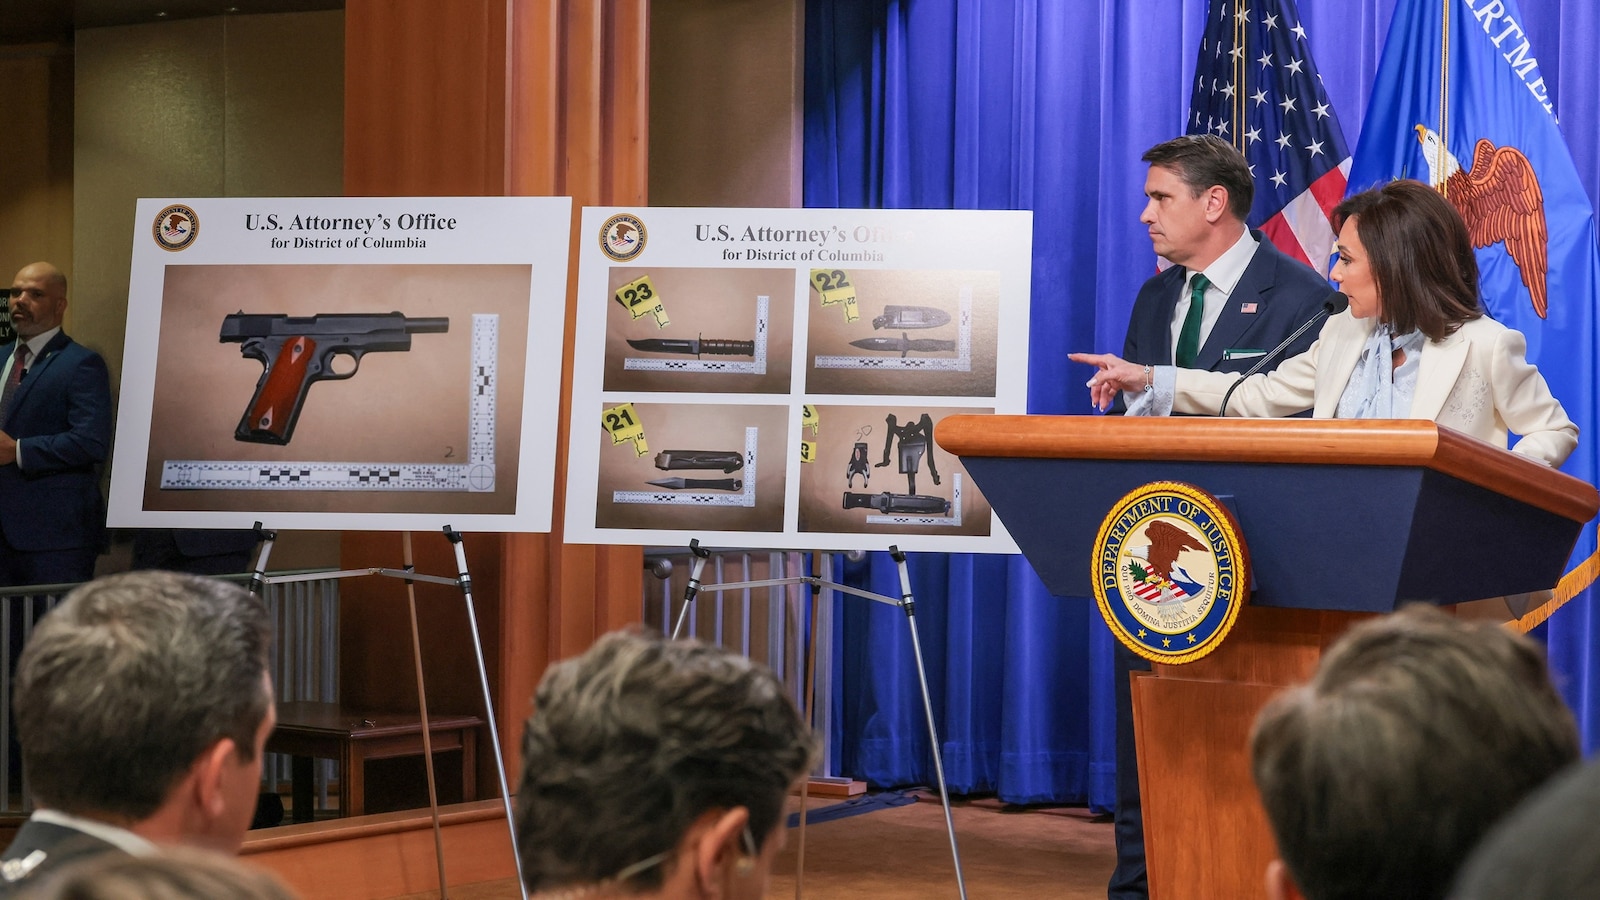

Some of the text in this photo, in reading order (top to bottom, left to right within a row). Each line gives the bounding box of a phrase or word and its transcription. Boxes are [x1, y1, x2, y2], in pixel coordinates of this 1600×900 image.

[1464, 0, 1559, 125] RTME
[246, 213, 457, 235] U.S. Attorney’s Office
[270, 237, 427, 249] for District of Columbia
[695, 224, 735, 242] U.S.
[740, 225, 847, 247] Attorney’s
[722, 249, 884, 262] for District of Columbia
[816, 269, 850, 291] 22
[624, 283, 653, 307] 23
[847, 296, 856, 305] 22
[606, 409, 634, 431] 21
[444, 446, 456, 459] 2
[1103, 496, 1232, 601] DEPARTMENT OF JUSTICE
[1124, 584, 1135, 601] PRO
[1132, 602, 1161, 628] DOMINA
[1163, 613, 1199, 629] JUSTITIA
[1196, 571, 1216, 616] SEQUITUR
